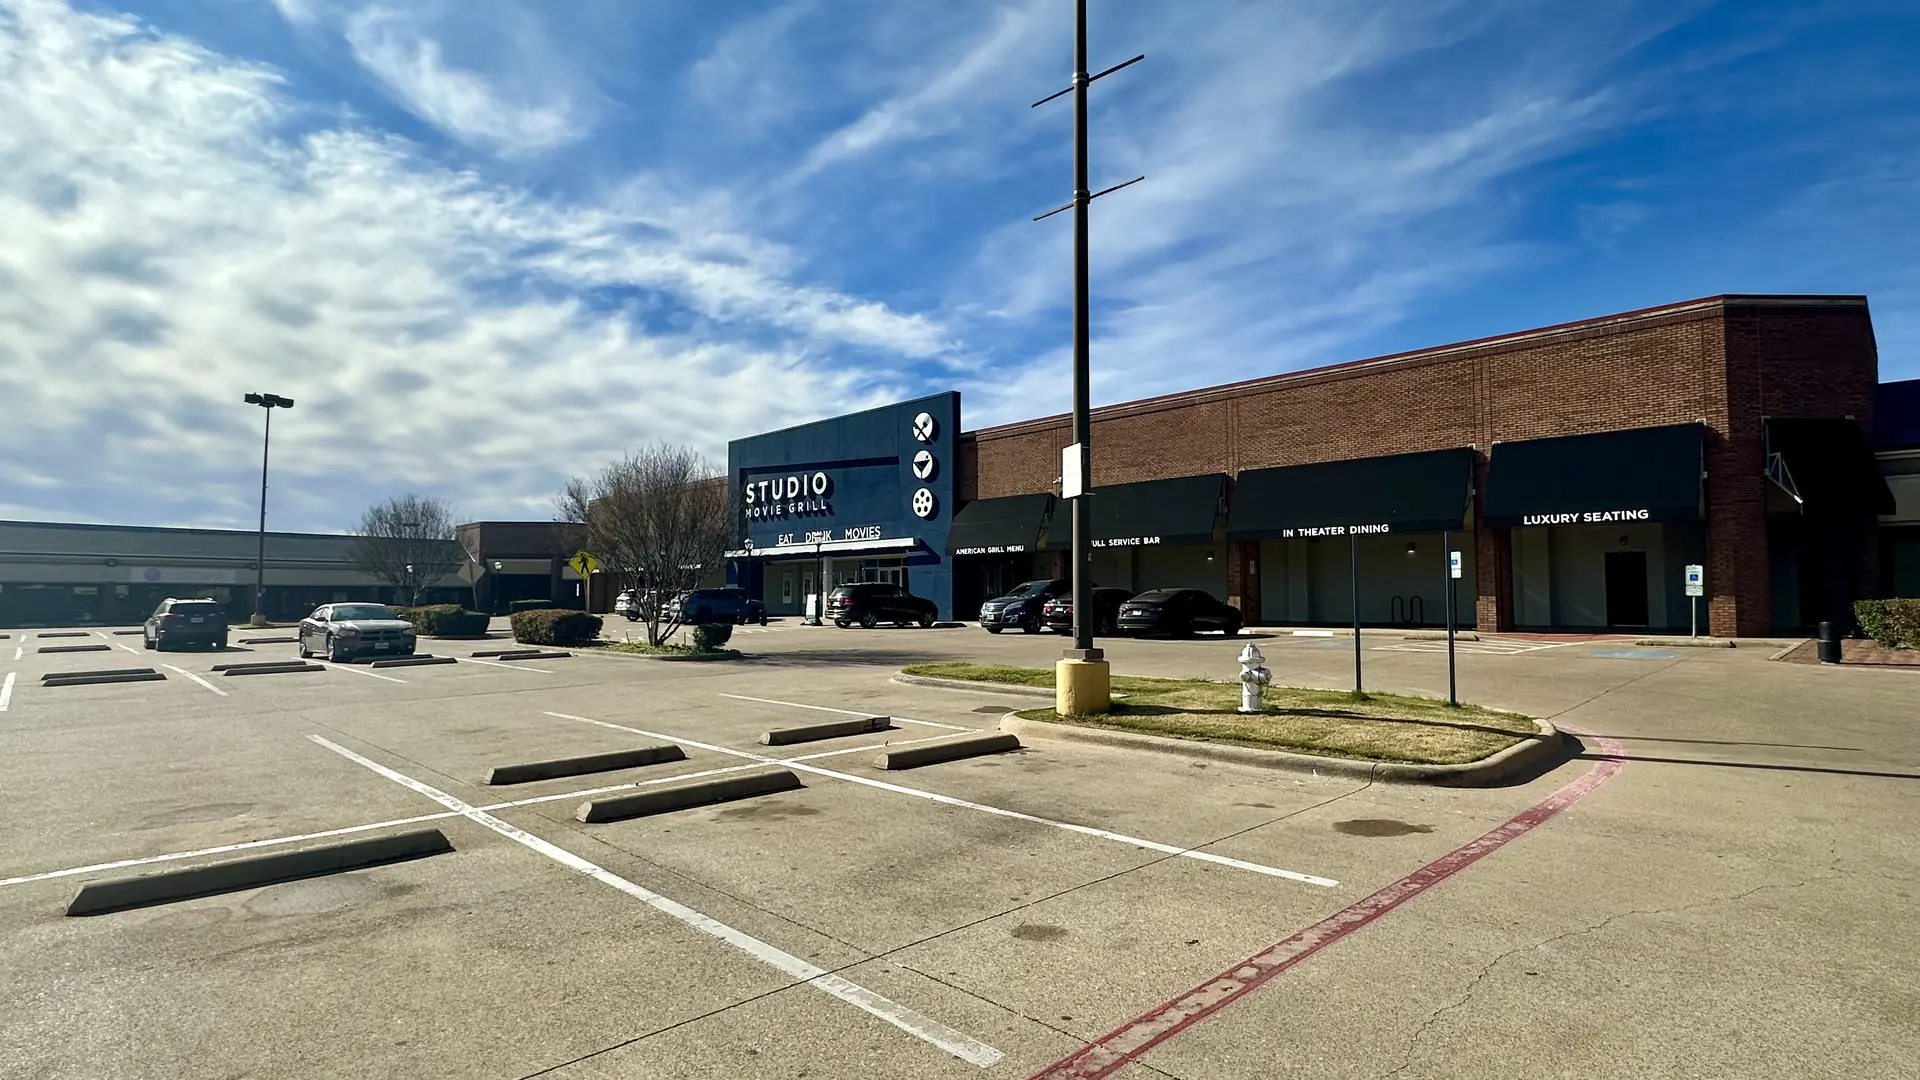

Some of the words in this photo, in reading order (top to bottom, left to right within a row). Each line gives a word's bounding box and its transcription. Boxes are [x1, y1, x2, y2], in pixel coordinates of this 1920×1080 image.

[746, 472, 827, 504] STUDIO
[746, 505, 781, 519] MOVIE
[789, 499, 827, 514] GRILL
[1523, 513, 1580, 525] LUXURY
[1583, 509, 1649, 523] SEATING
[778, 533, 794, 544] EAT
[845, 526, 881, 540] MOVIES
[1282, 529, 1294, 538] IN
[1298, 526, 1345, 537] THEATER
[1349, 524, 1389, 535] DINING
[1108, 537, 1141, 546] SERVICE
[1143, 536, 1160, 544] BAR
[956, 547, 986, 555] AMERICAN
